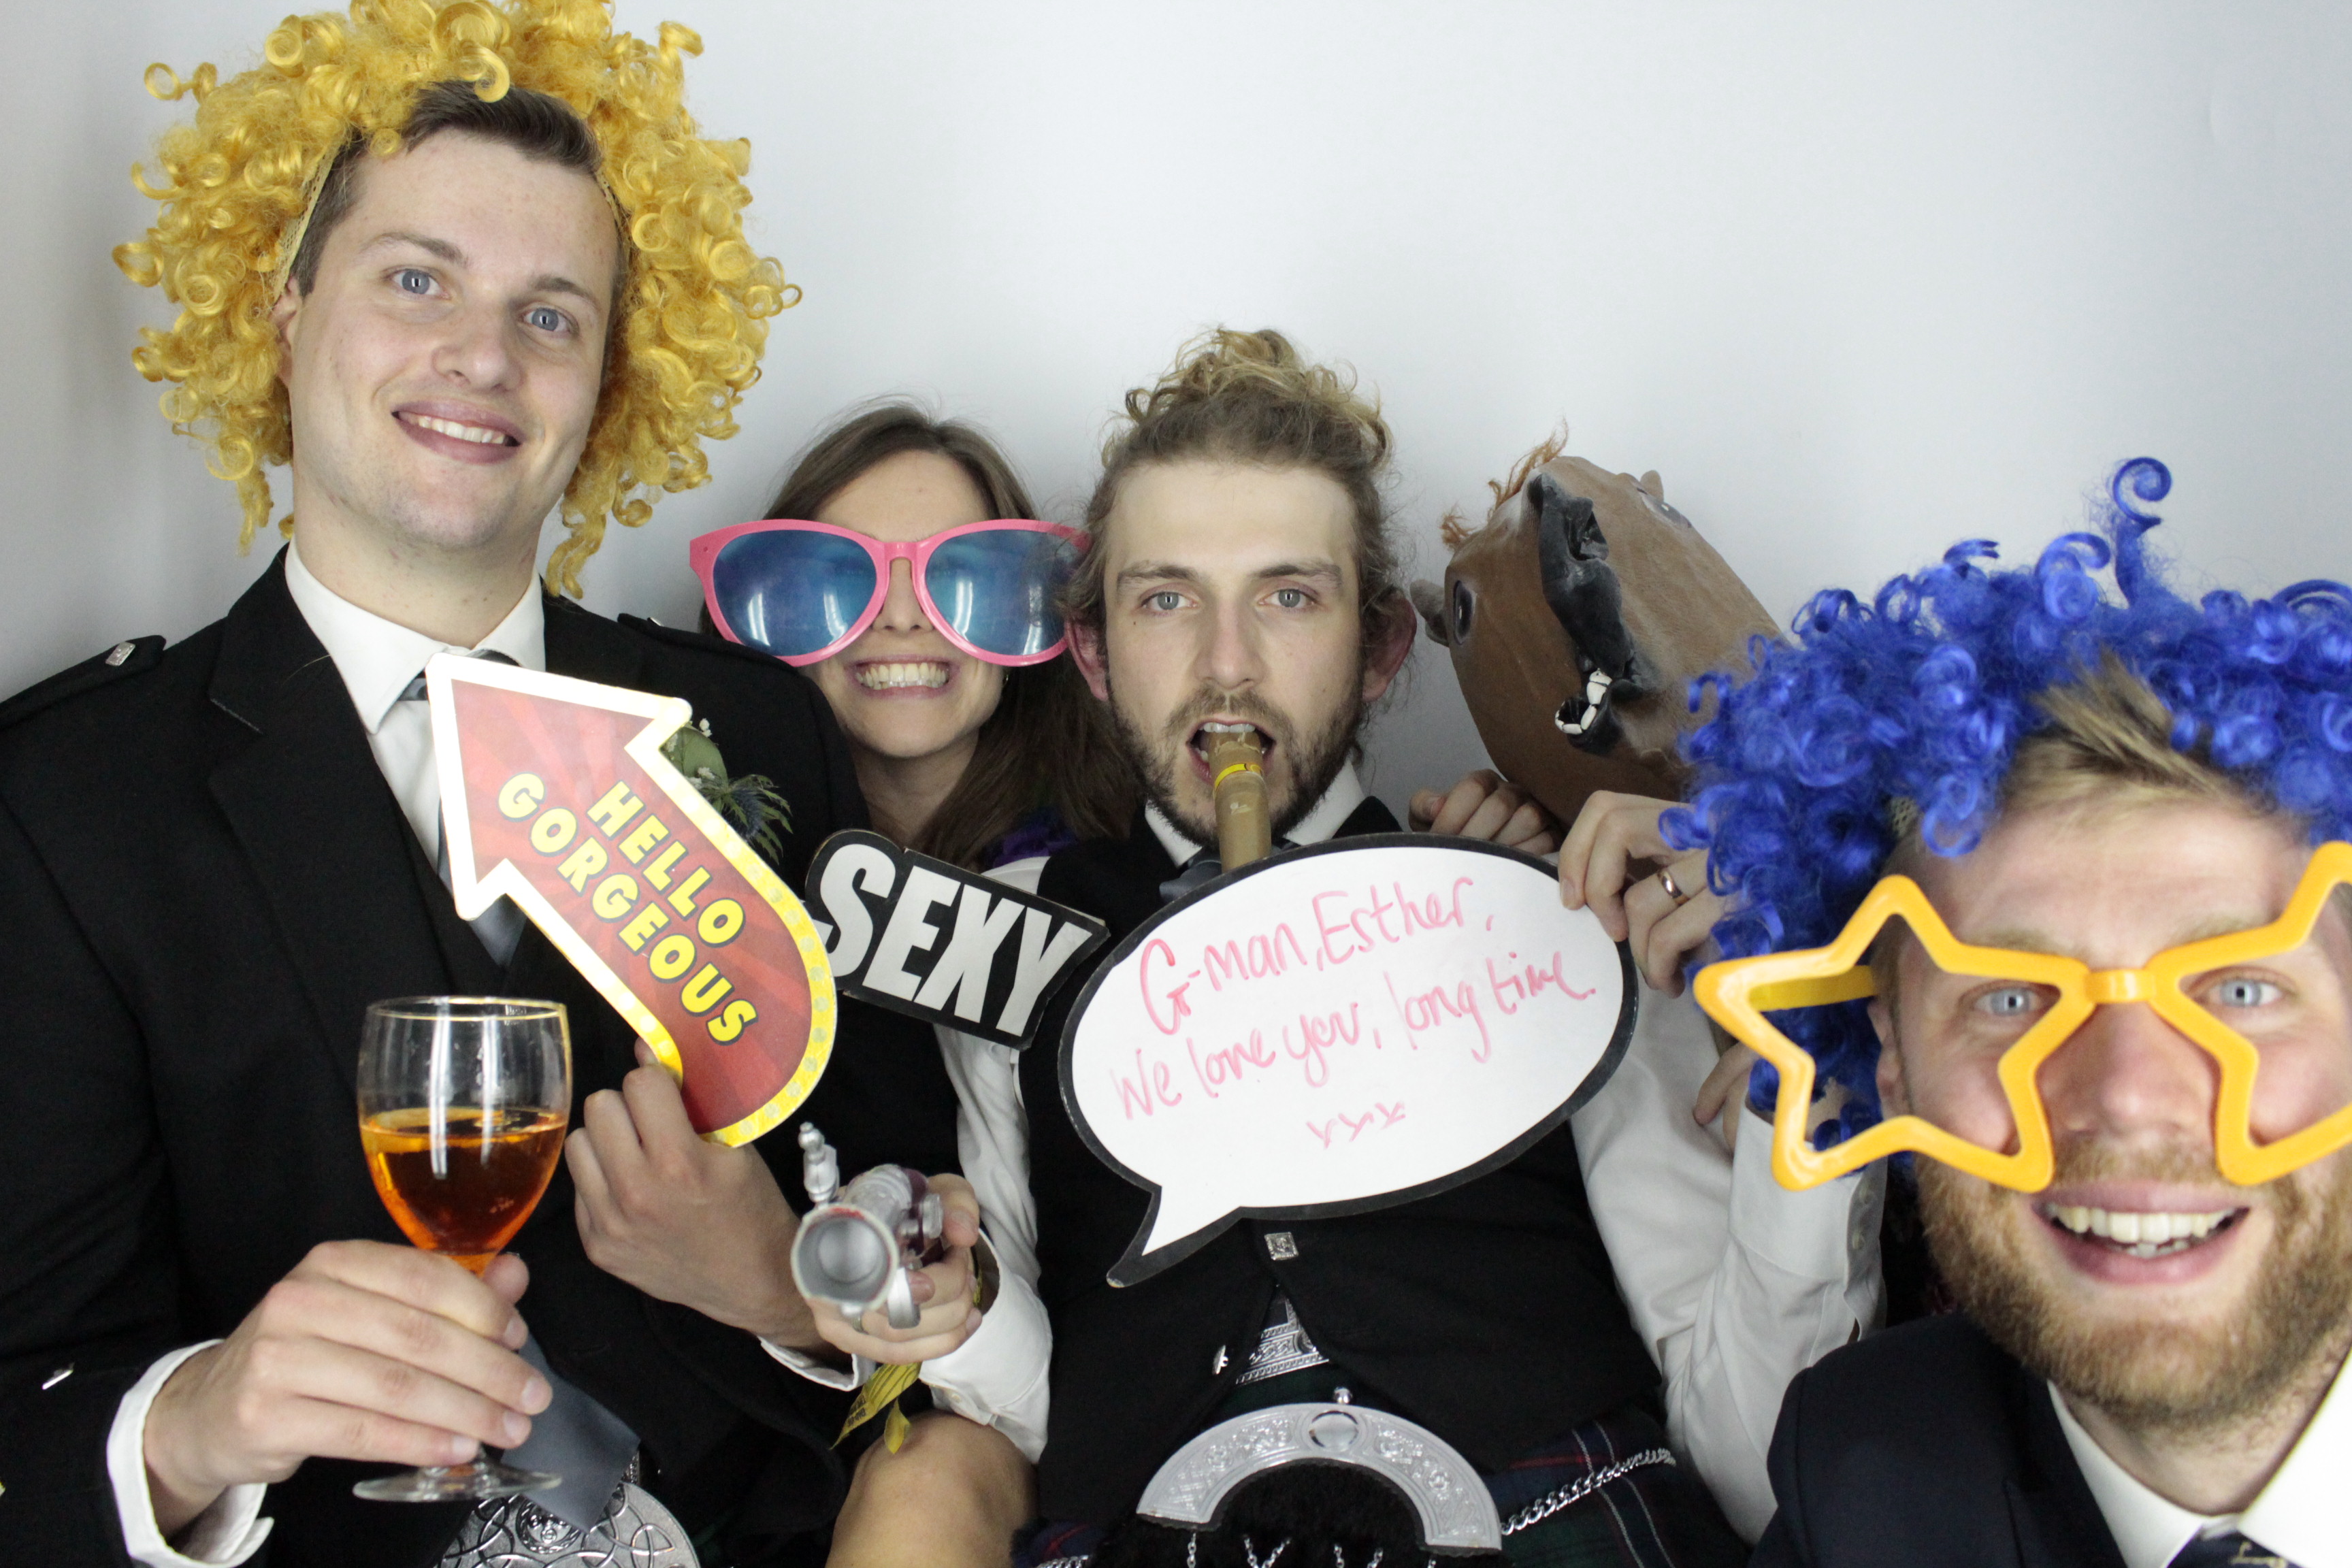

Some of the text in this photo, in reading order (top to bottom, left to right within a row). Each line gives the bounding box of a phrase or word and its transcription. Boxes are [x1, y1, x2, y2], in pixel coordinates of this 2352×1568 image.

[497, 772, 758, 1045] GORGEOUS
[587, 780, 746, 947] HELLO
[813, 844, 1092, 1037] SEXY
[1109, 1048, 1182, 1120] We
[1382, 970, 1491, 1064] long
